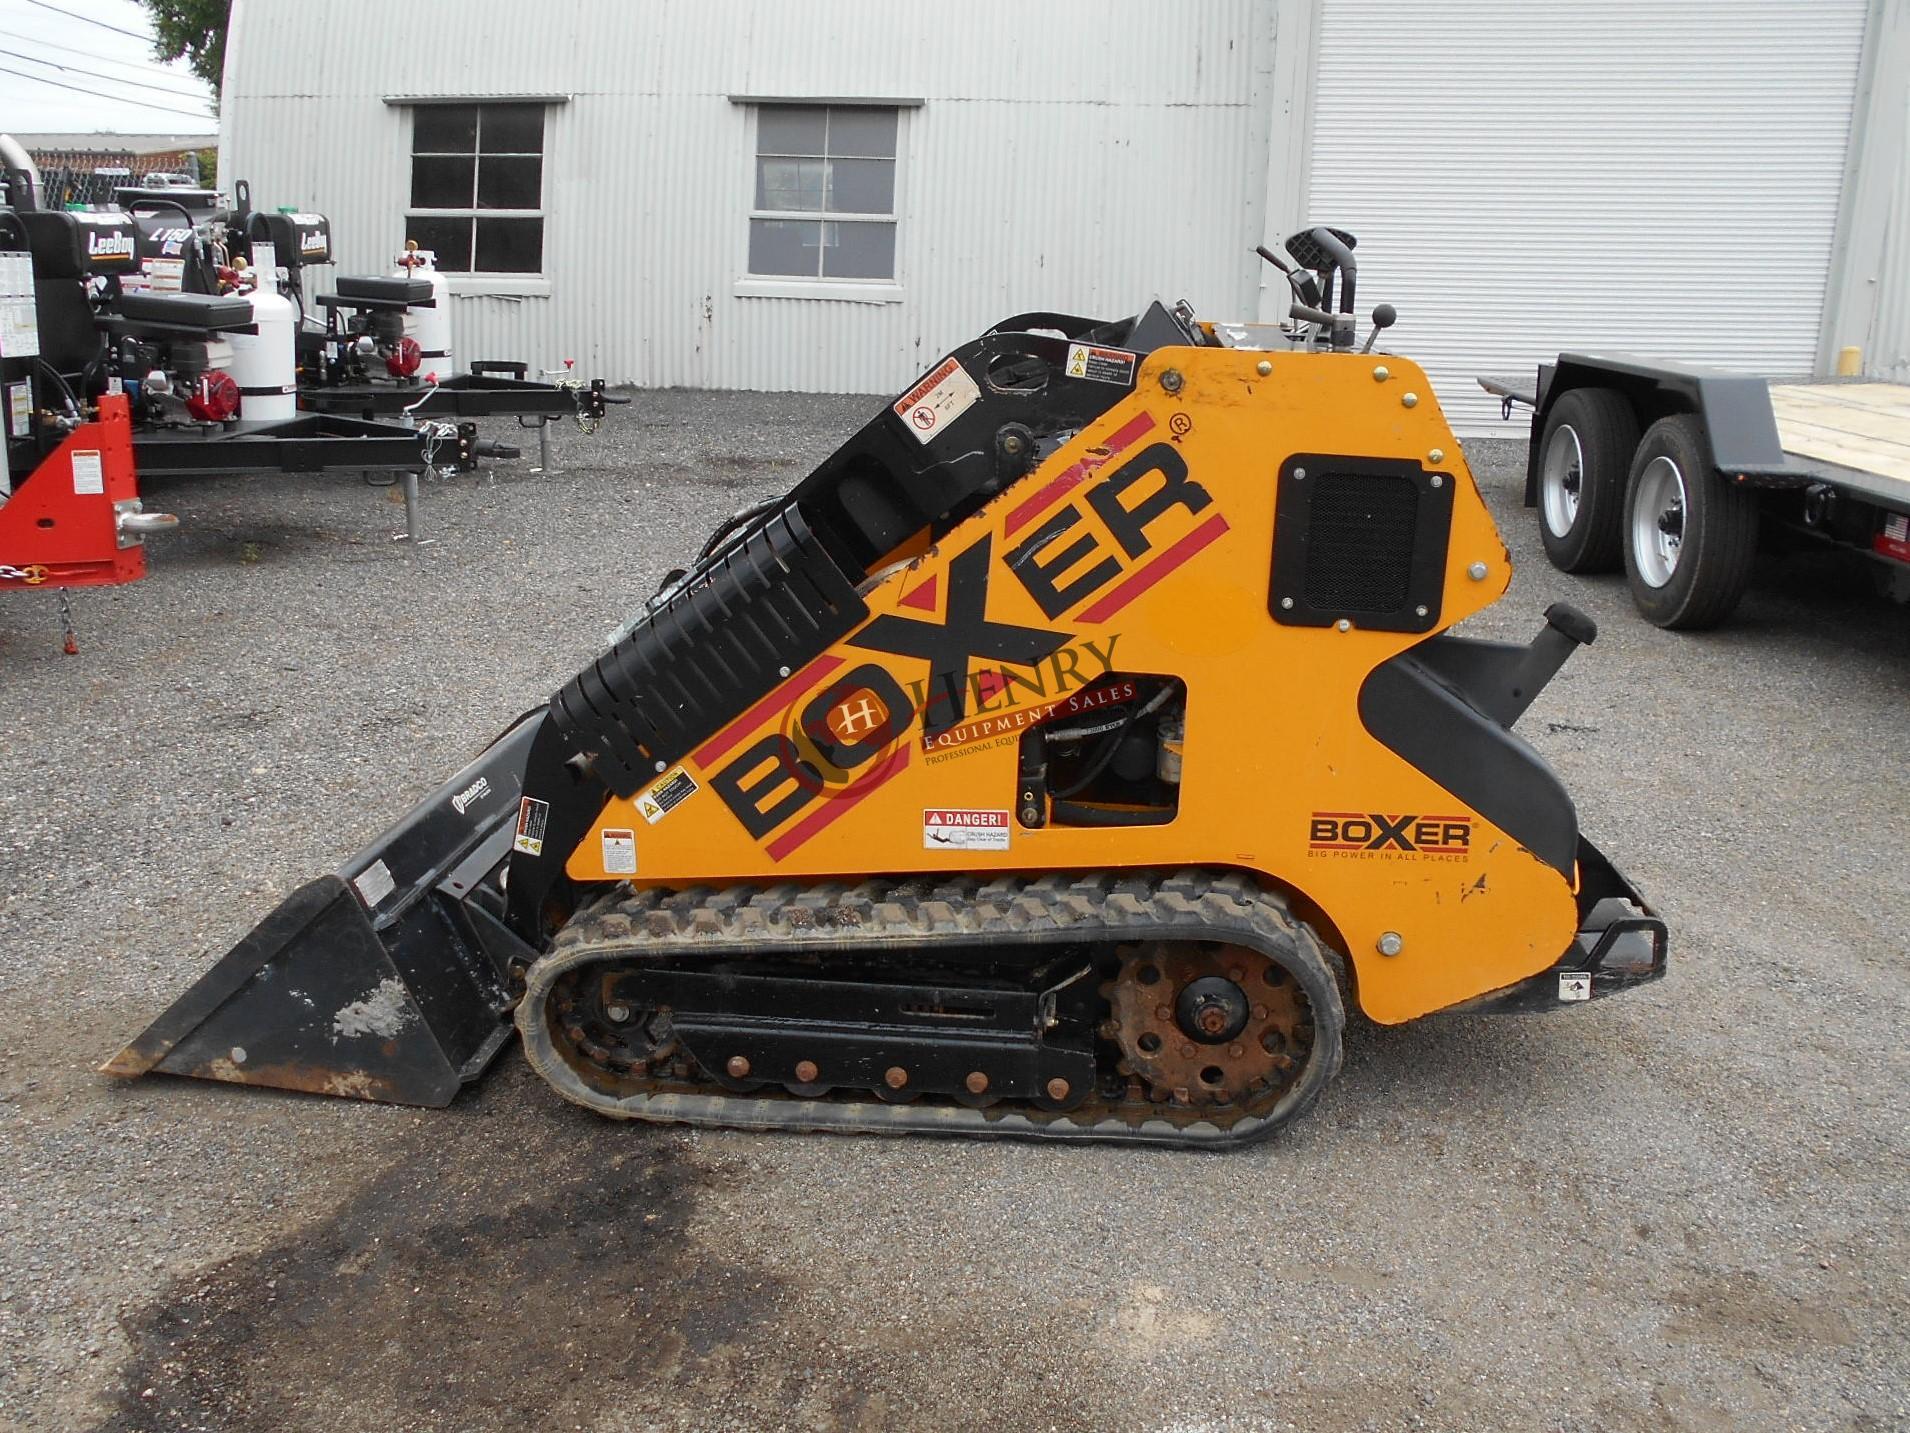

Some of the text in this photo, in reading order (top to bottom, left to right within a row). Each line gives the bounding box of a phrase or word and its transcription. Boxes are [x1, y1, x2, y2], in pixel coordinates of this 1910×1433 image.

[89, 231, 134, 260] LeeBoy
[910, 362, 957, 407] WARNING
[708, 442, 1214, 841] BOXER
[461, 777, 487, 804] BRADCO
[945, 813, 1002, 826] DANGER!
[1310, 814, 1471, 851] BOXER
[1307, 850, 1469, 863] BIG POWER IN ALL PLACES
